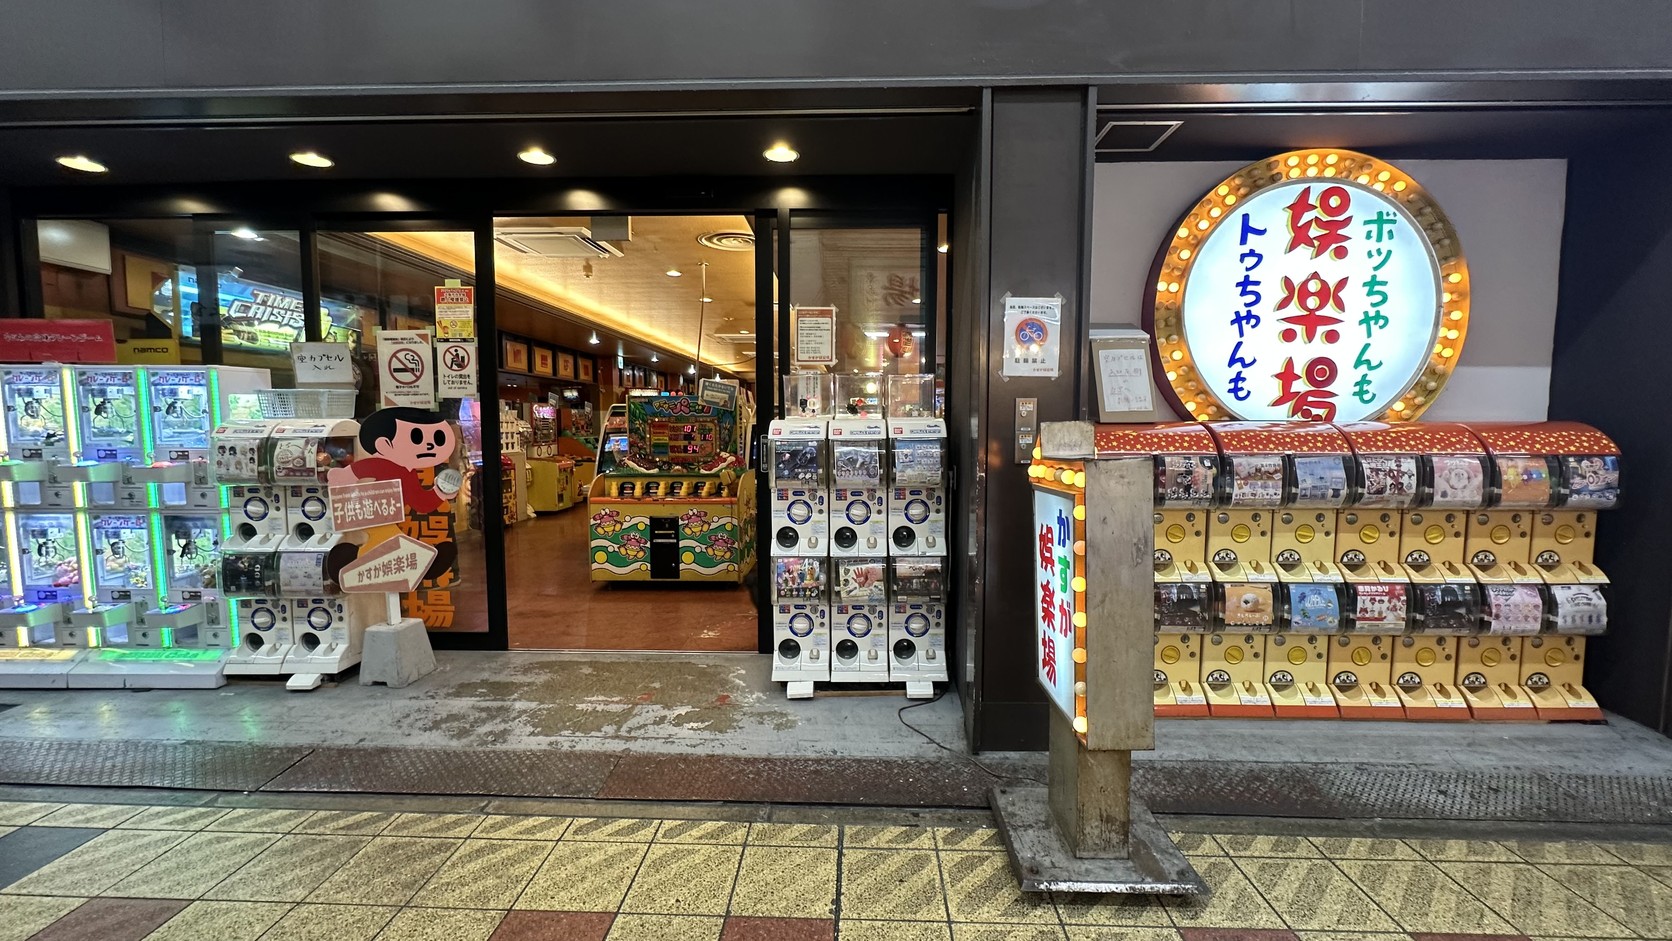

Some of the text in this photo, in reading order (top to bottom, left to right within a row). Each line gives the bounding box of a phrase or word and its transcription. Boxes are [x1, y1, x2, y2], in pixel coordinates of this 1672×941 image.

[253, 290, 304, 312] TIME
[1268, 186, 1354, 422] 娯楽場
[133, 346, 169, 354] namco
[334, 498, 401, 523] 子供も遊べるよー
[357, 552, 418, 583] かすが娯楽場
[1057, 508, 1073, 639] かすが
[1039, 523, 1057, 688] 娯楽場
